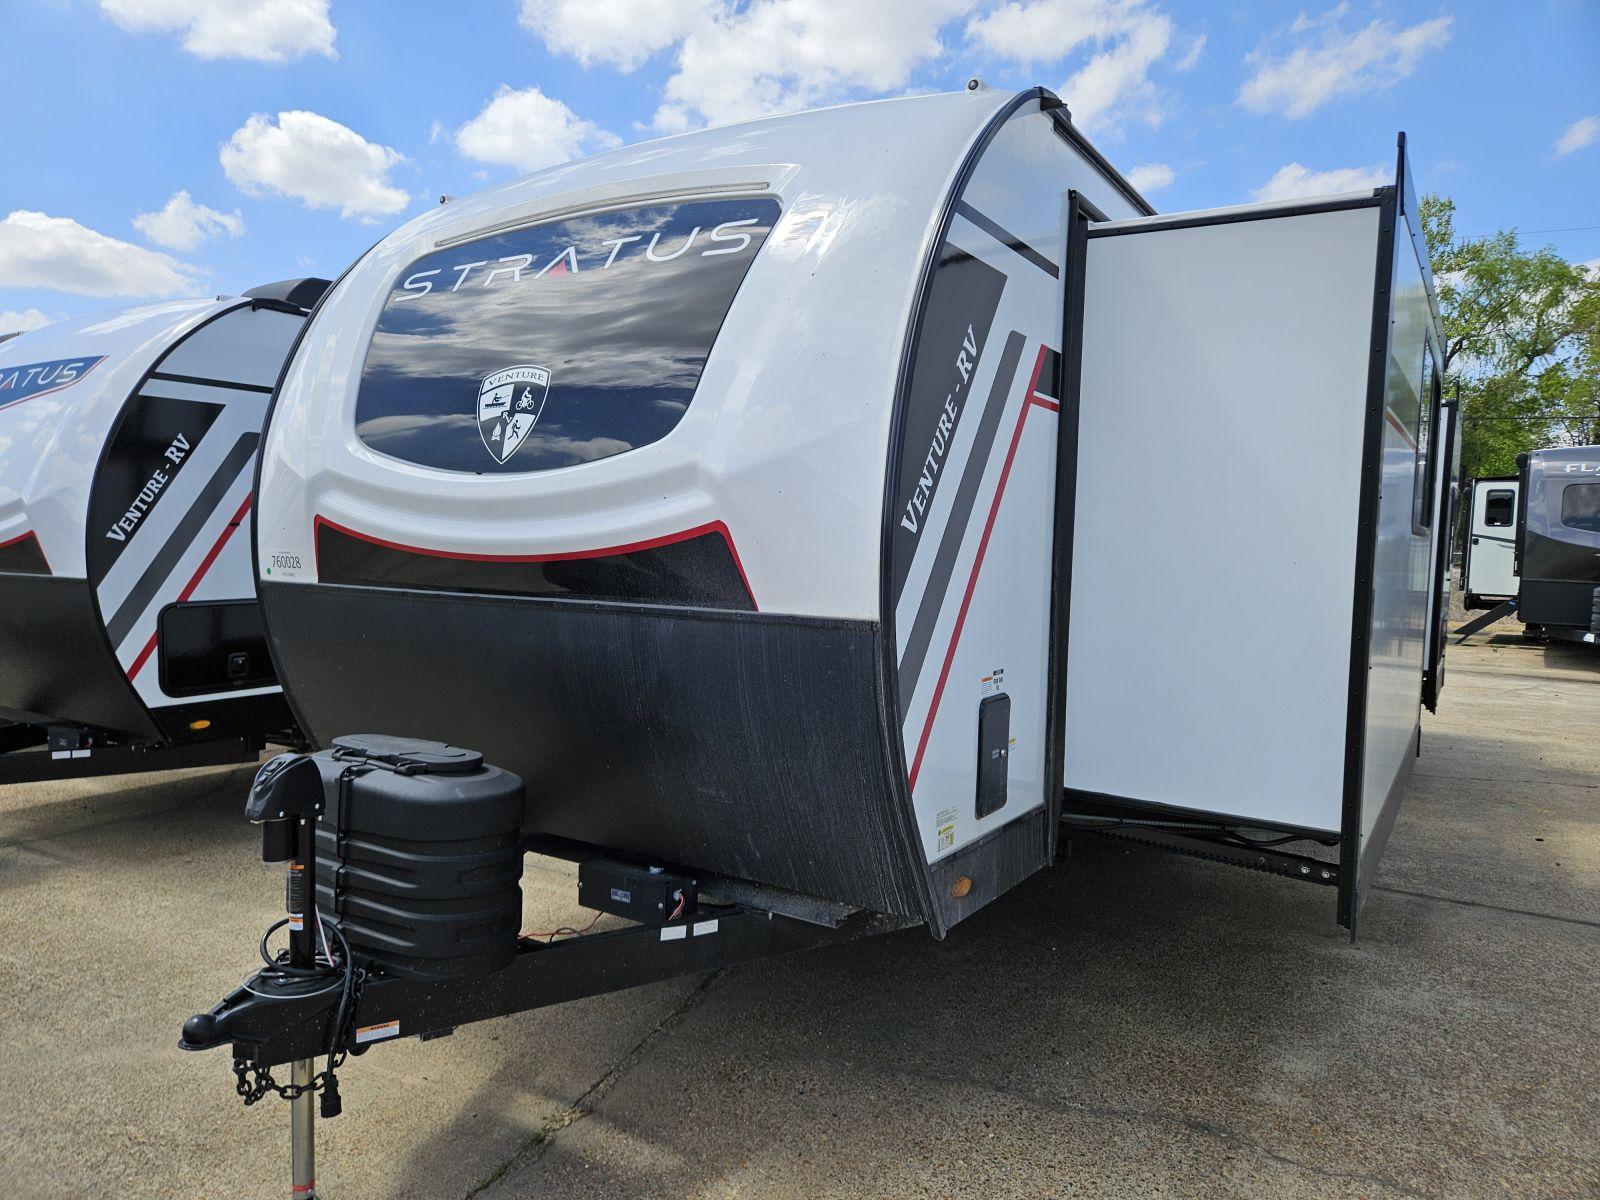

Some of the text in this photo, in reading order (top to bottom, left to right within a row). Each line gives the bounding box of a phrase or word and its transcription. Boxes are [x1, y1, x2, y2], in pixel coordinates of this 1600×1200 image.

[395, 218, 759, 302] STRATUS
[0, 362, 84, 389] ATUS
[489, 371, 544, 386] VENTURE
[900, 394, 958, 535] VENTURE
[955, 324, 979, 385] RV
[106, 470, 168, 541] VENTURE
[165, 433, 191, 464] RV
[271, 555, 302, 569] 760028
